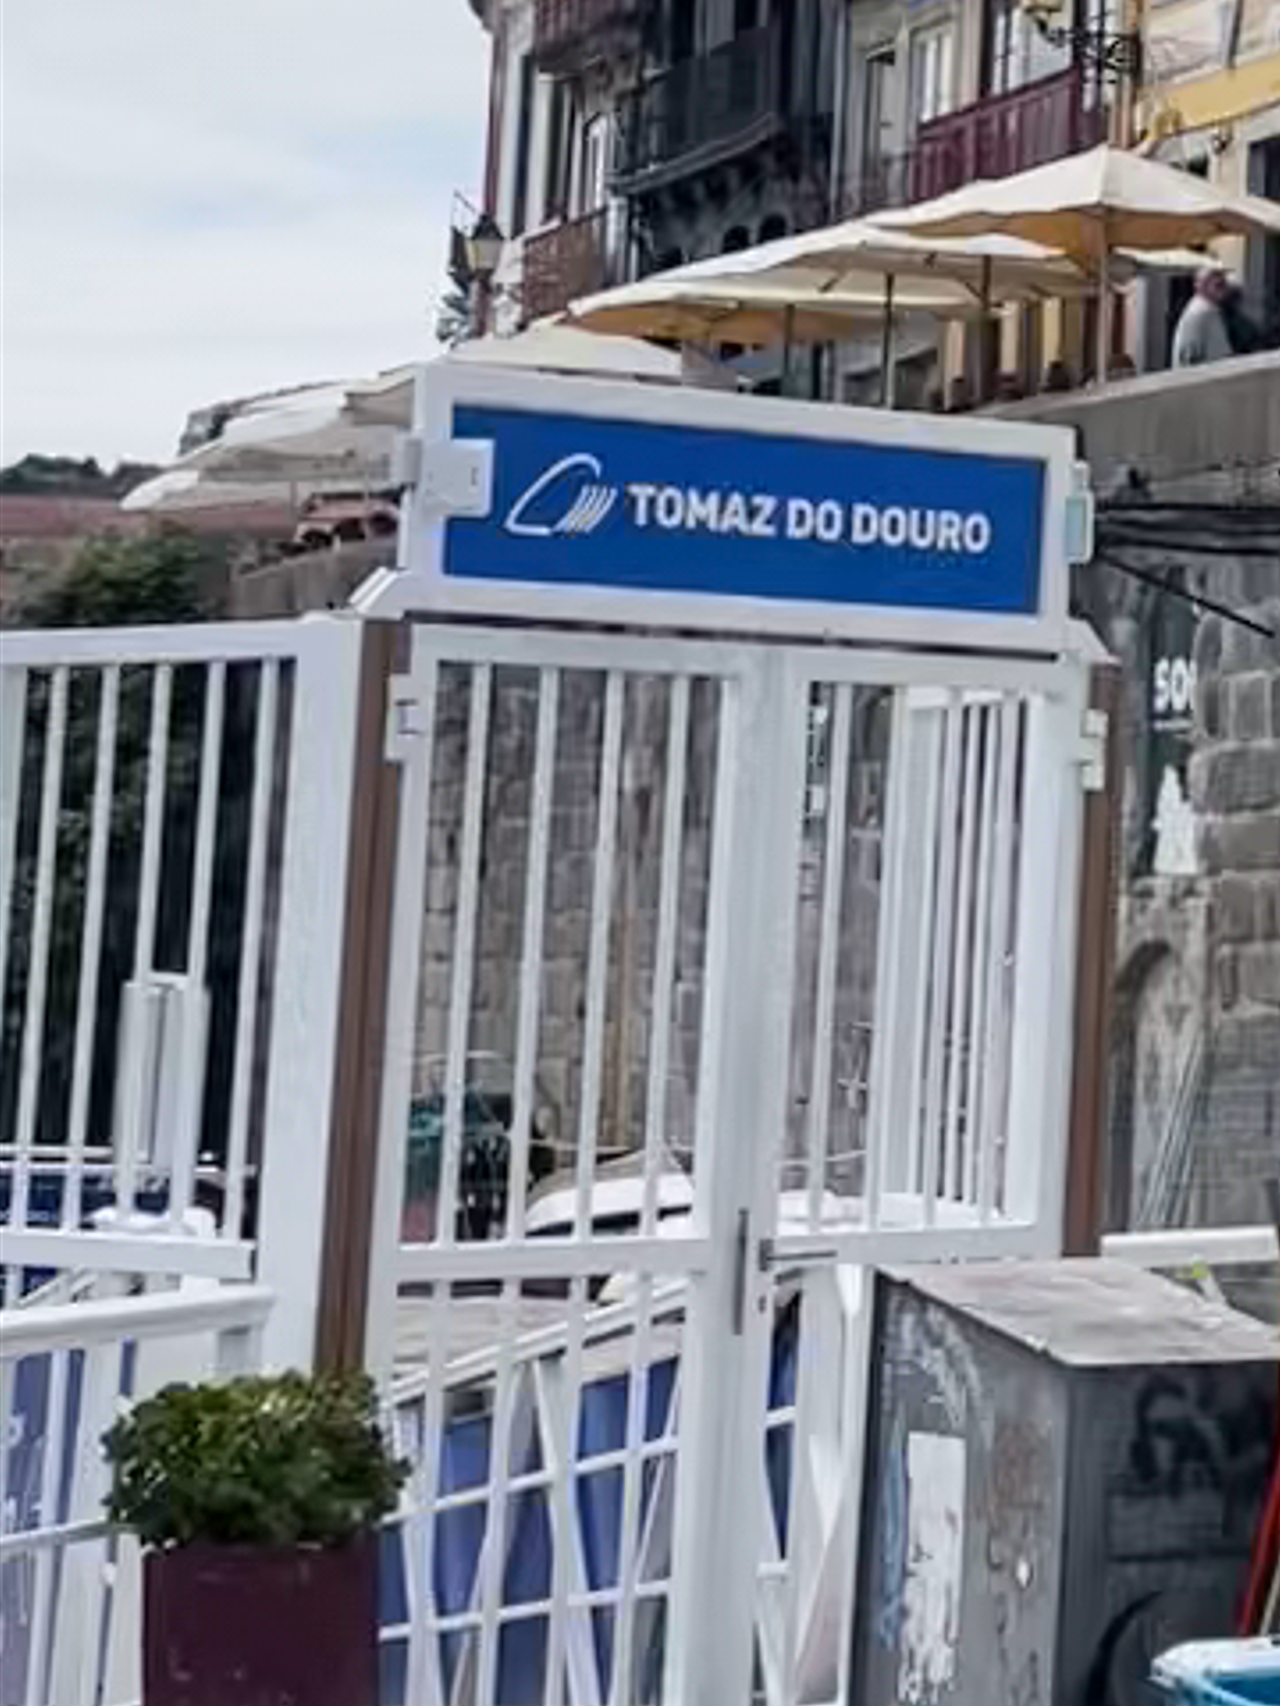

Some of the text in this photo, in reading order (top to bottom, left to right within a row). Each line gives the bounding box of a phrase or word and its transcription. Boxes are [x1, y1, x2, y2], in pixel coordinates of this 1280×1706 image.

[628, 483, 990, 554] TOMAZ DO DOURO
[1154, 657, 1197, 713] SO
